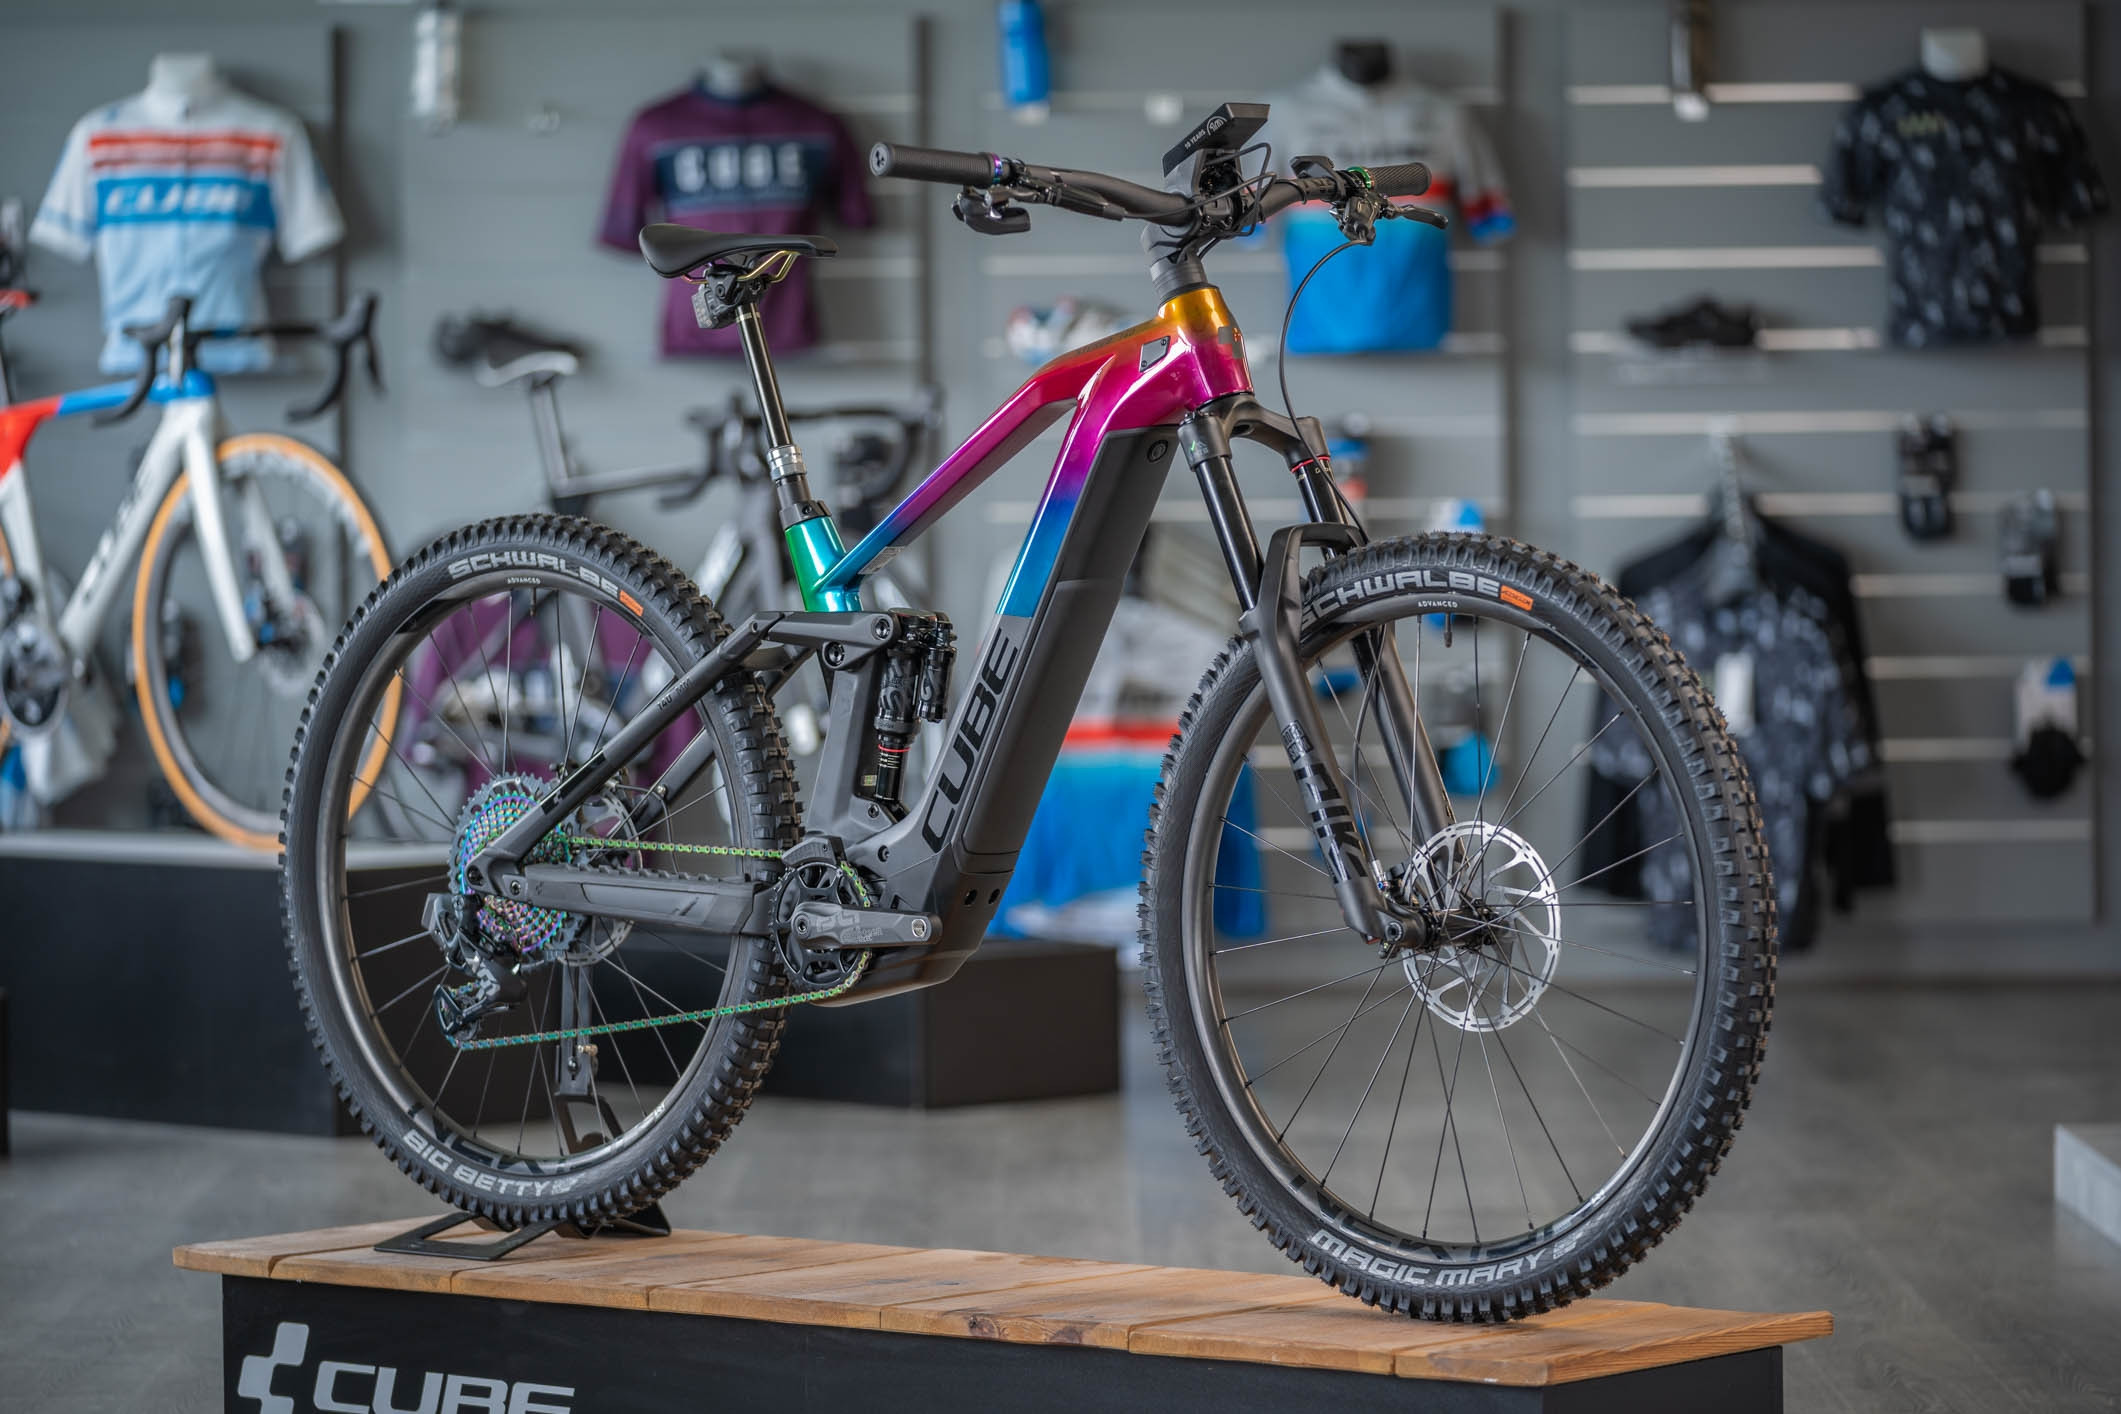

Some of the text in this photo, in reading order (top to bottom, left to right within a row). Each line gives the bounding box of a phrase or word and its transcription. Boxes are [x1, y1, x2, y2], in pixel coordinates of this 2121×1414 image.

[448, 551, 619, 599] SCHWALBE
[922, 628, 1018, 854] CUBE
[403, 1129, 452, 1172] BIG
[453, 1165, 551, 1197] BETTY
[1311, 1229, 1547, 1287] MAGIC MARY
